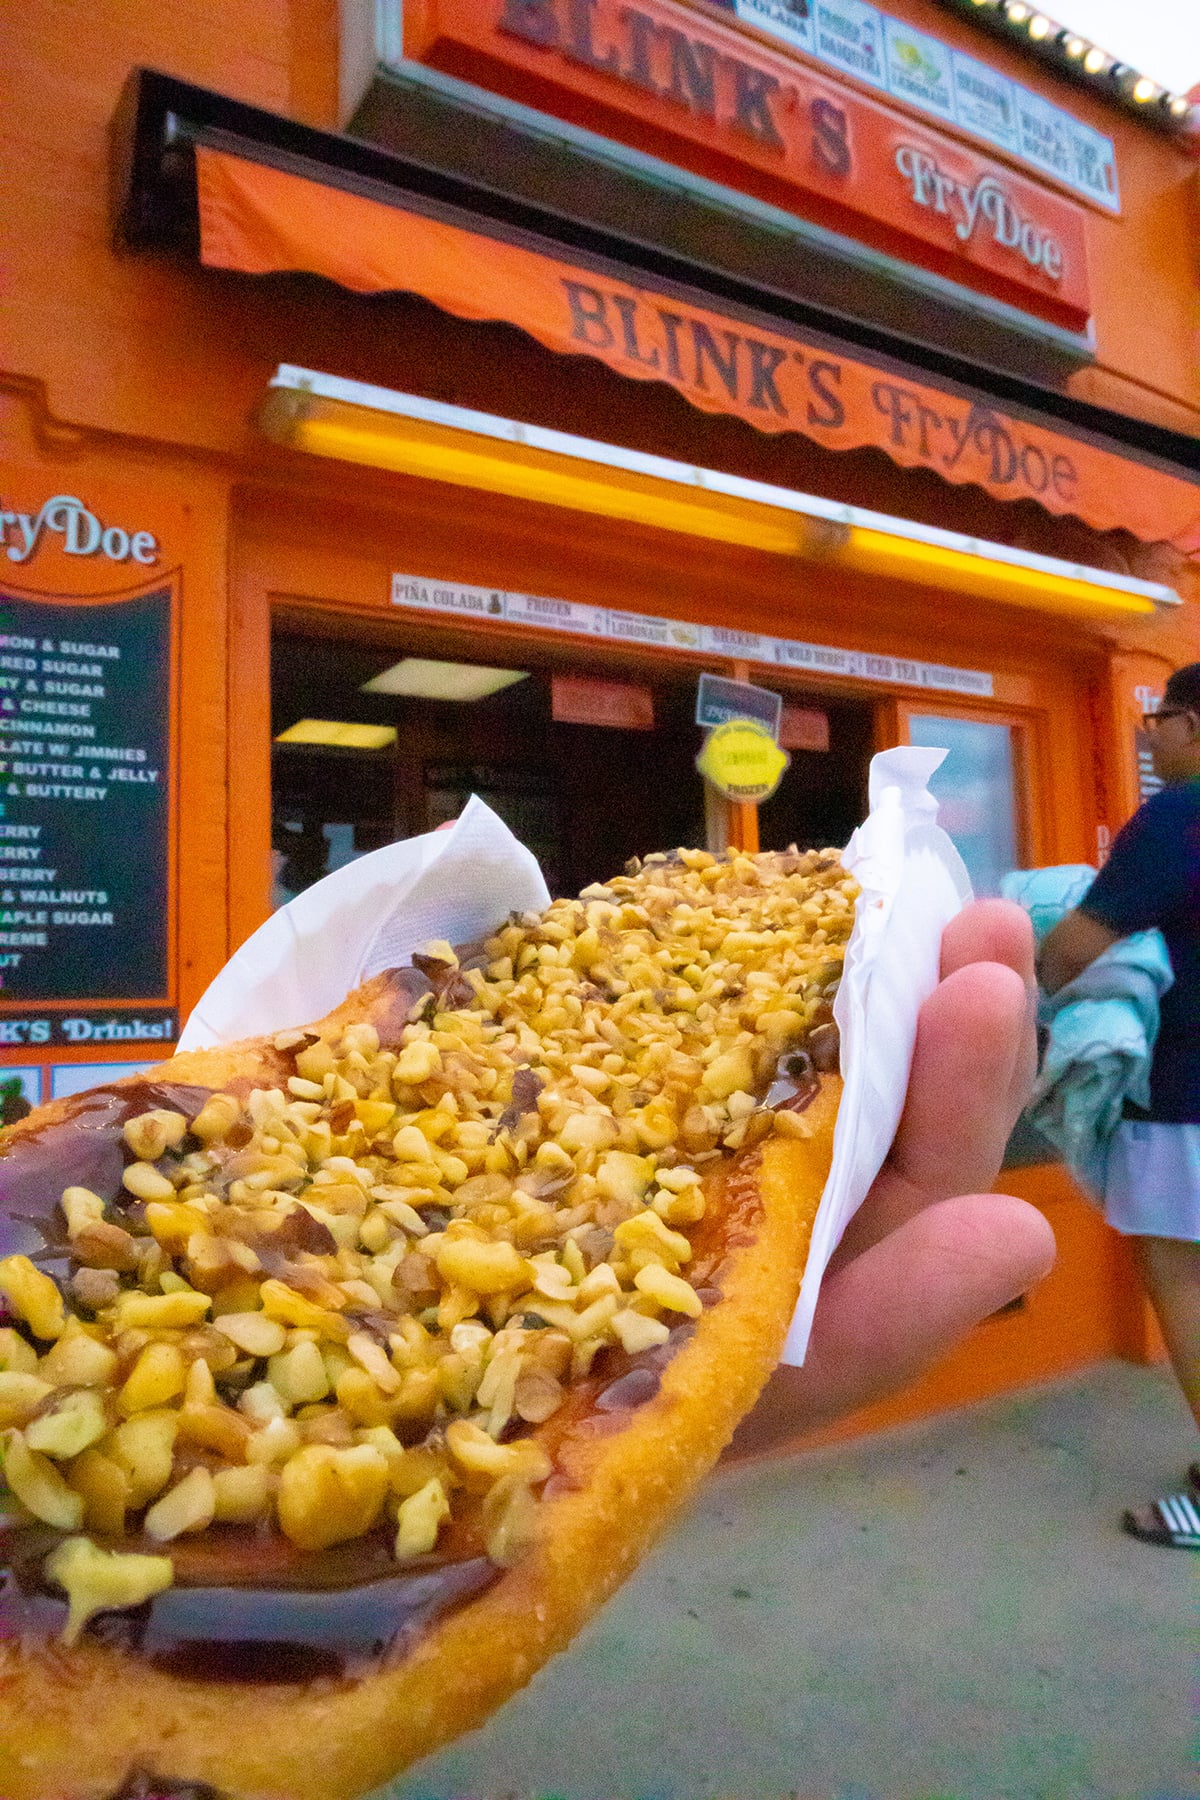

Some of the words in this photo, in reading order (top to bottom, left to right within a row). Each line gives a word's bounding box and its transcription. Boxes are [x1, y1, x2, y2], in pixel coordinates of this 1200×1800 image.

[561, 277, 846, 430] BLINK'S
[395, 581, 429, 602] PIÑA
[433, 590, 484, 612] COLADA
[60, 641, 121, 659] SUGAR
[42, 659, 103, 677] SUGAR
[44, 680, 105, 697] SUGAR
[20, 700, 91, 717] CHEESE
[0, 719, 95, 738] CINNAMON
[74, 745, 148, 762] JIMMIES
[13, 762, 84, 778] BUTTER
[107, 767, 159, 782] JELLY
[26, 783, 108, 800] BUTTERY
[20, 890, 109, 904] WALNUTS
[52, 911, 114, 926] SUGAR
[61, 1018, 173, 1041] Drinks!
